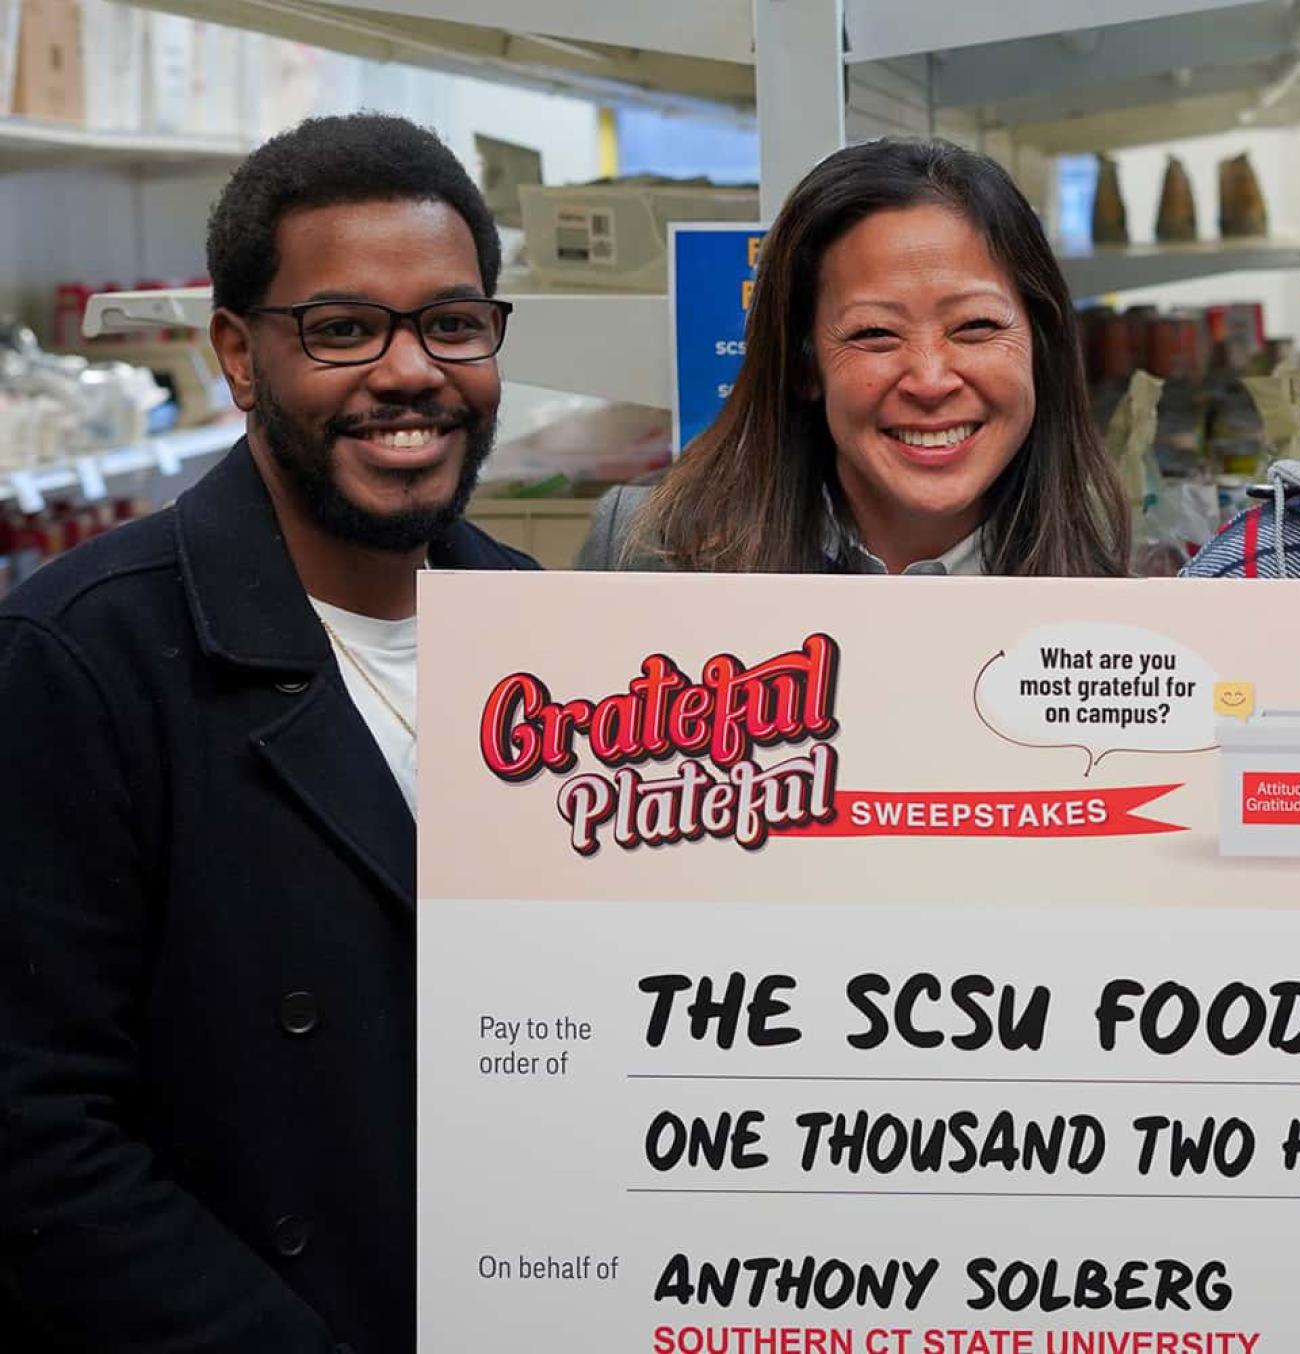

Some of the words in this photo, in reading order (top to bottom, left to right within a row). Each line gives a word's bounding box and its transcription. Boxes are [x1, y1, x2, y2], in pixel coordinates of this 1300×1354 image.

[715, 341, 747, 355] SCS
[1041, 648, 1093, 668] What
[1100, 654, 1132, 669] are
[1140, 654, 1175, 675] you
[1021, 677, 1071, 695] most
[1078, 676, 1159, 702] grateful
[1167, 677, 1195, 697] for
[480, 633, 839, 783] Grateful
[1046, 708, 1069, 722] on
[1077, 704, 1170, 728] campus?
[557, 742, 838, 857] Plateful
[852, 799, 1106, 827] SWEEPSTAKES
[639, 972, 802, 1049] THE
[847, 973, 1050, 1051] SCSU
[481, 1016, 520, 1044] Pay
[527, 1019, 547, 1039] to
[556, 1017, 590, 1040] the
[480, 1051, 539, 1074] order
[547, 1051, 568, 1074] of
[646, 1111, 768, 1171] ONE
[796, 1110, 1105, 1174] THOUSAND
[1133, 1116, 1255, 1177] TWO
[479, 1256, 510, 1278] On
[520, 1256, 590, 1278] behalf
[597, 1256, 618, 1279] of
[654, 1254, 939, 1310] ANTHONY
[967, 1258, 1232, 1312] SOLBERG
[655, 1326, 852, 1354] SOUTHERN
[866, 1329, 912, 1354] CT
[924, 1329, 1032, 1354] STATE
[1046, 1330, 1259, 1354] UNIVERSITY
